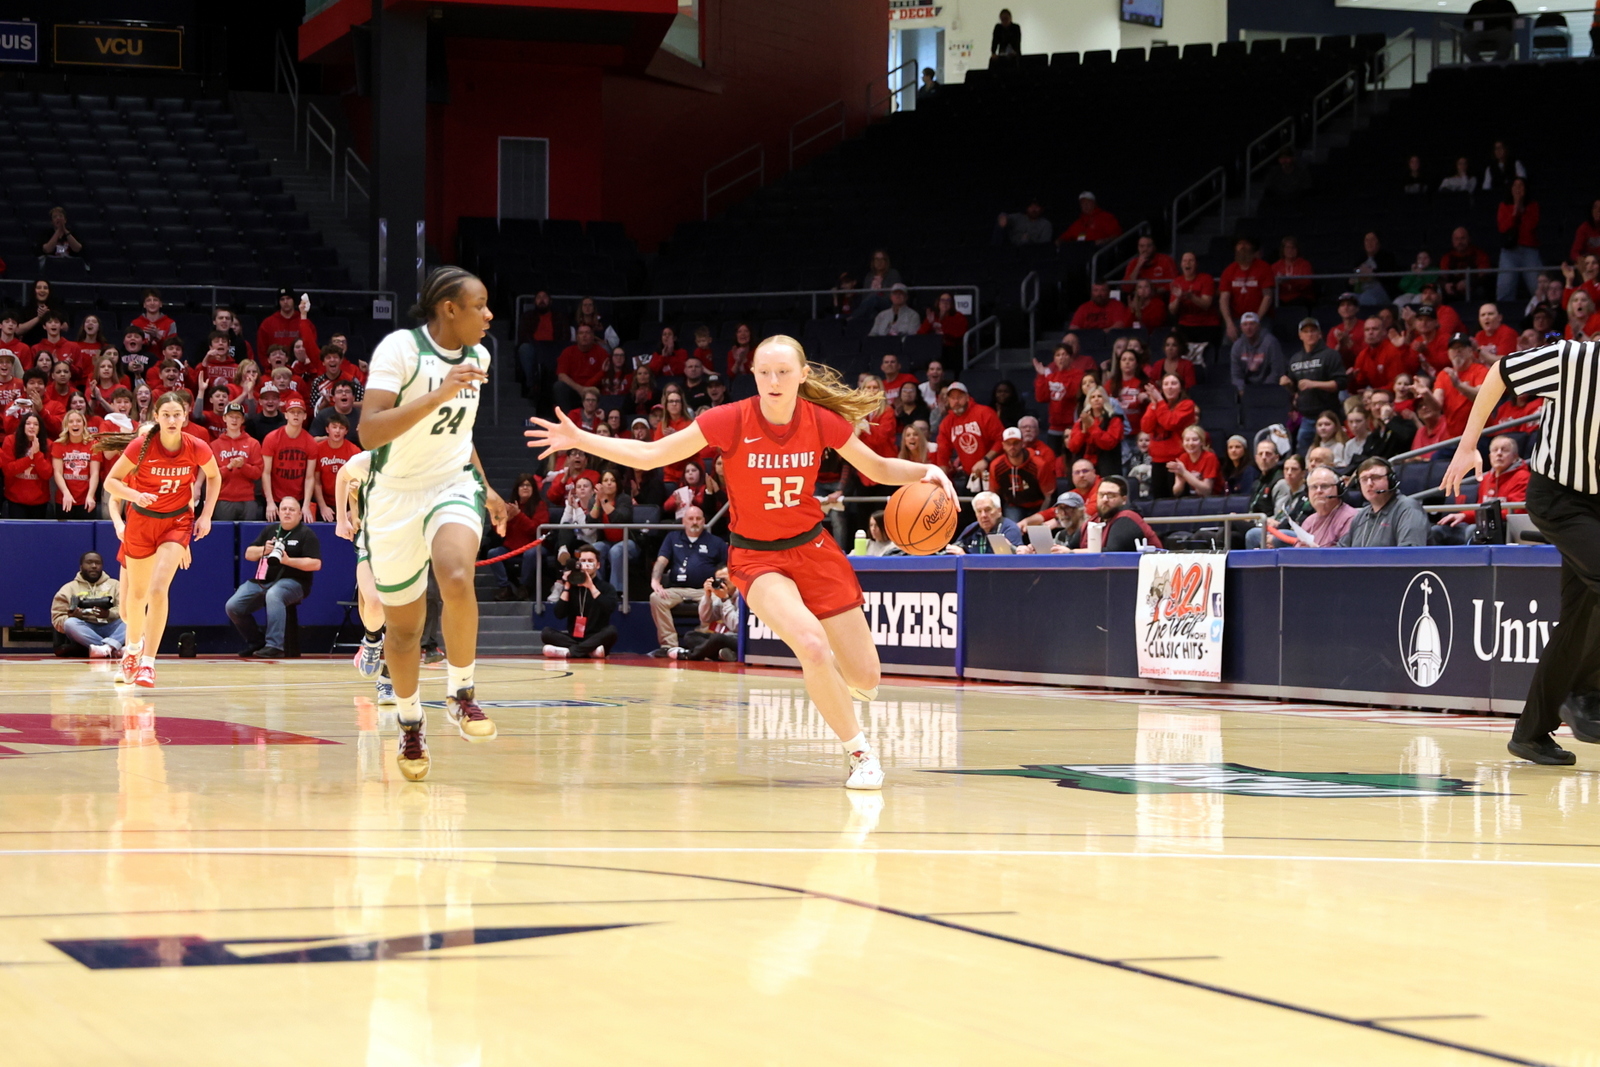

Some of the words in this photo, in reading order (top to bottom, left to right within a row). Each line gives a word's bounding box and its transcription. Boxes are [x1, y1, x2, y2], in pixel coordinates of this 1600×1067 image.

[899, 7, 934, 20] DECK
[0, 34, 32, 50] UIS
[94, 37, 143, 56] VCU
[375, 305, 390, 314] 109
[430, 406, 467, 435] 24
[220, 447, 249, 462] Redmen
[278, 449, 306, 461] STATE
[747, 451, 816, 469] BELLEVUE
[150, 466, 192, 477] BELLEVUE
[158, 479, 182, 494] 21
[761, 475, 804, 511] 32
[1163, 562, 1212, 619] 92.1
[1146, 619, 1168, 642] The
[1169, 612, 1206, 639] Wolf
[1182, 642, 1203, 660] HITS
